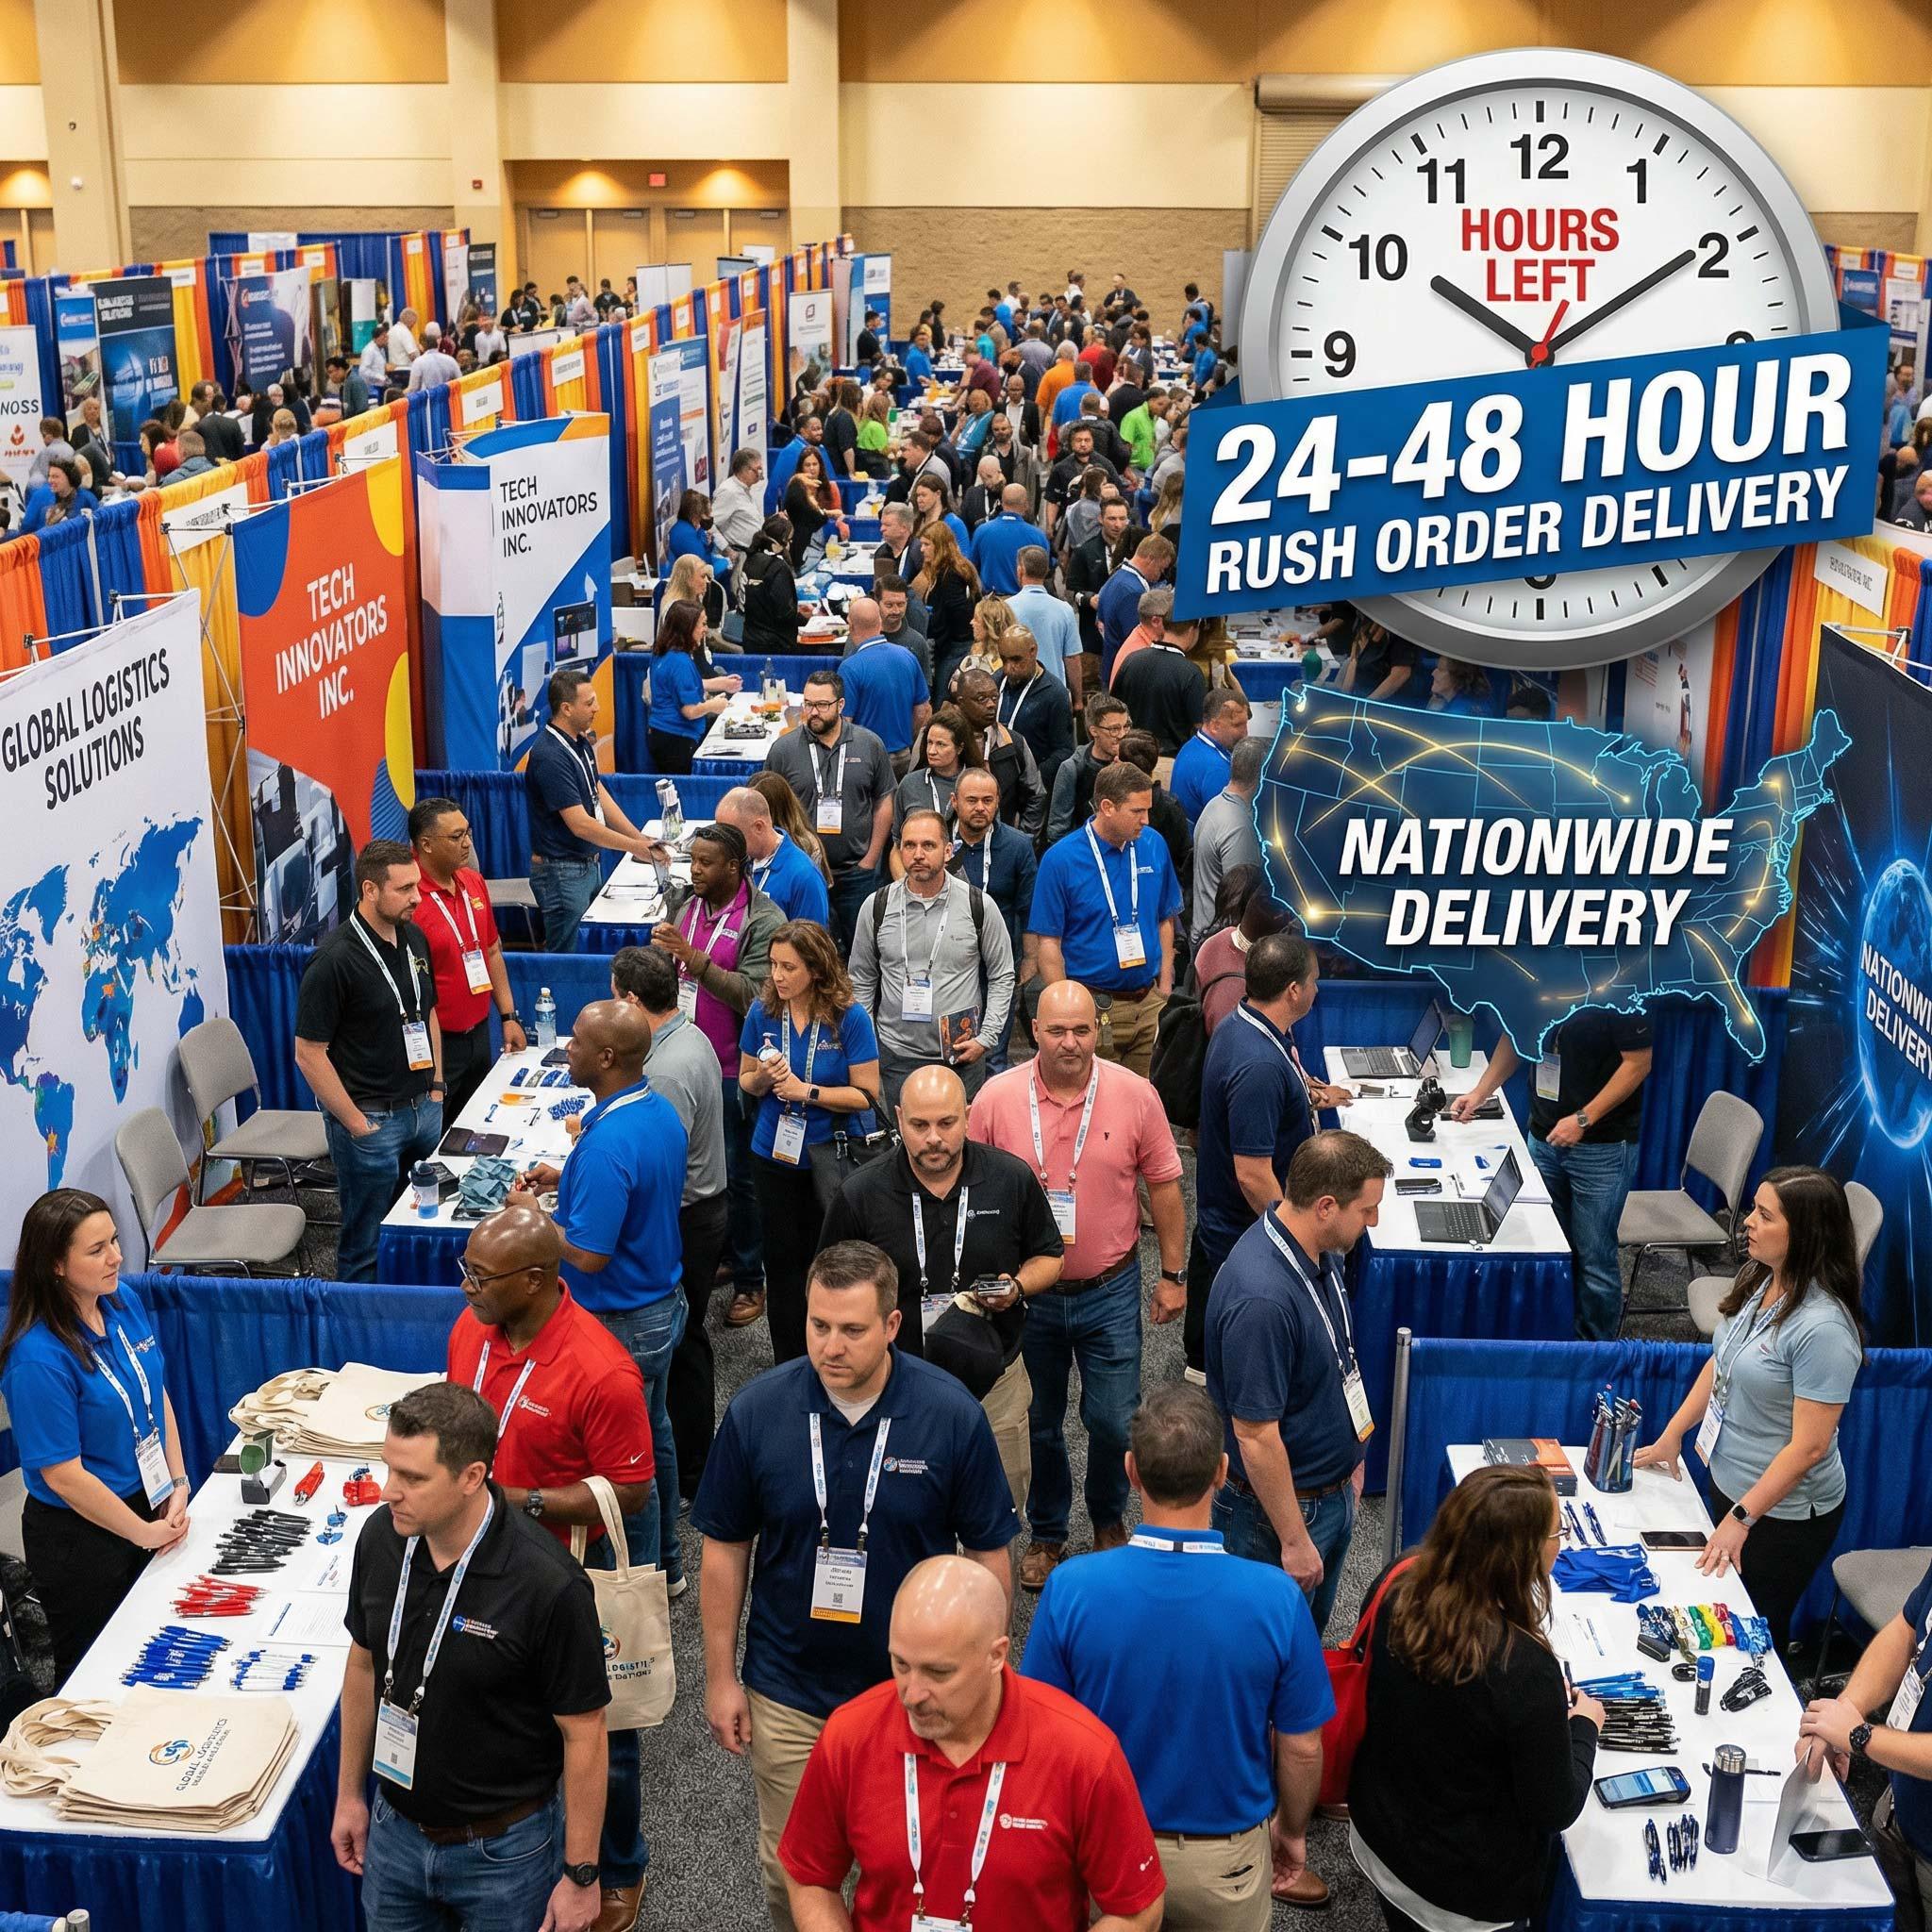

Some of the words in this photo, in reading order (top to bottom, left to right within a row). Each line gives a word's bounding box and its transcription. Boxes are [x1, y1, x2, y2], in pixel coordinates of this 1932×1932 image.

[499, 475, 538, 504] TECH
[501, 491, 598, 531] INNOVATORS
[502, 532, 532, 558] INC.
[307, 563, 356, 621] TECH
[275, 594, 388, 694] INNOVATORS
[1, 695, 79, 773] GLOBAL
[81, 647, 171, 732] LOGISTICS
[318, 666, 355, 720] INC.
[44, 715, 145, 811] SOLUTIONS
[1860, 940, 1932, 1037] NATIONWI
